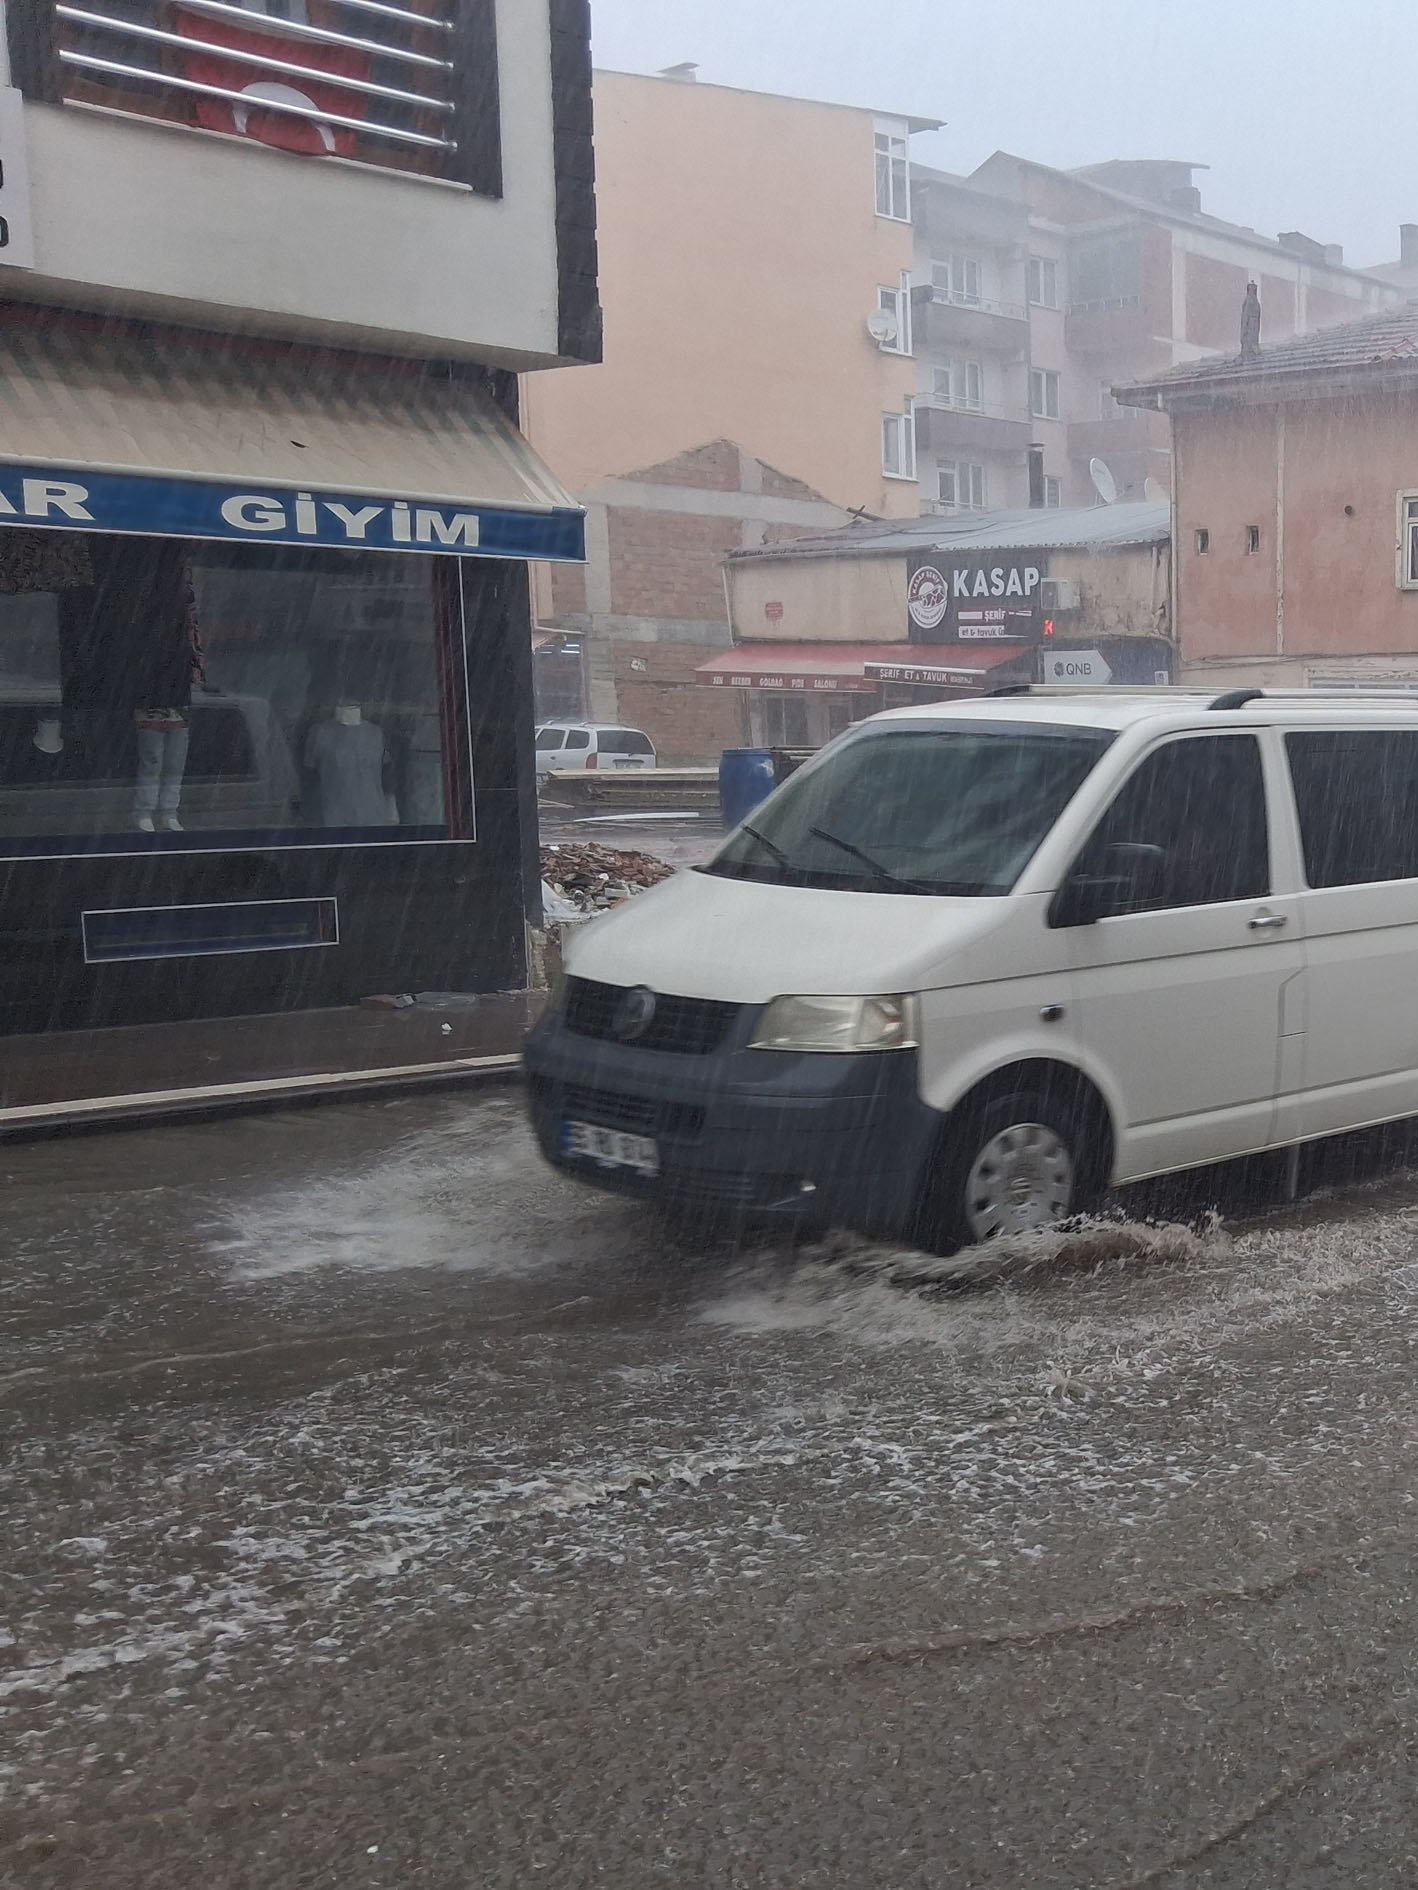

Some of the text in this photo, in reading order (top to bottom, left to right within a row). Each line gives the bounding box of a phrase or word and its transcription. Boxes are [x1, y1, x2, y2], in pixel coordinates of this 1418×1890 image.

[220, 492, 480, 546] GİYİM
[953, 567, 1040, 598] KASAP
[983, 608, 1007, 623] ŞERİF
[977, 626, 998, 638] tavuk
[879, 668, 901, 680] ŞERİF
[904, 670, 915, 680] ET
[922, 671, 948, 683] TAVUK
[1066, 662, 1092, 676] QNB
